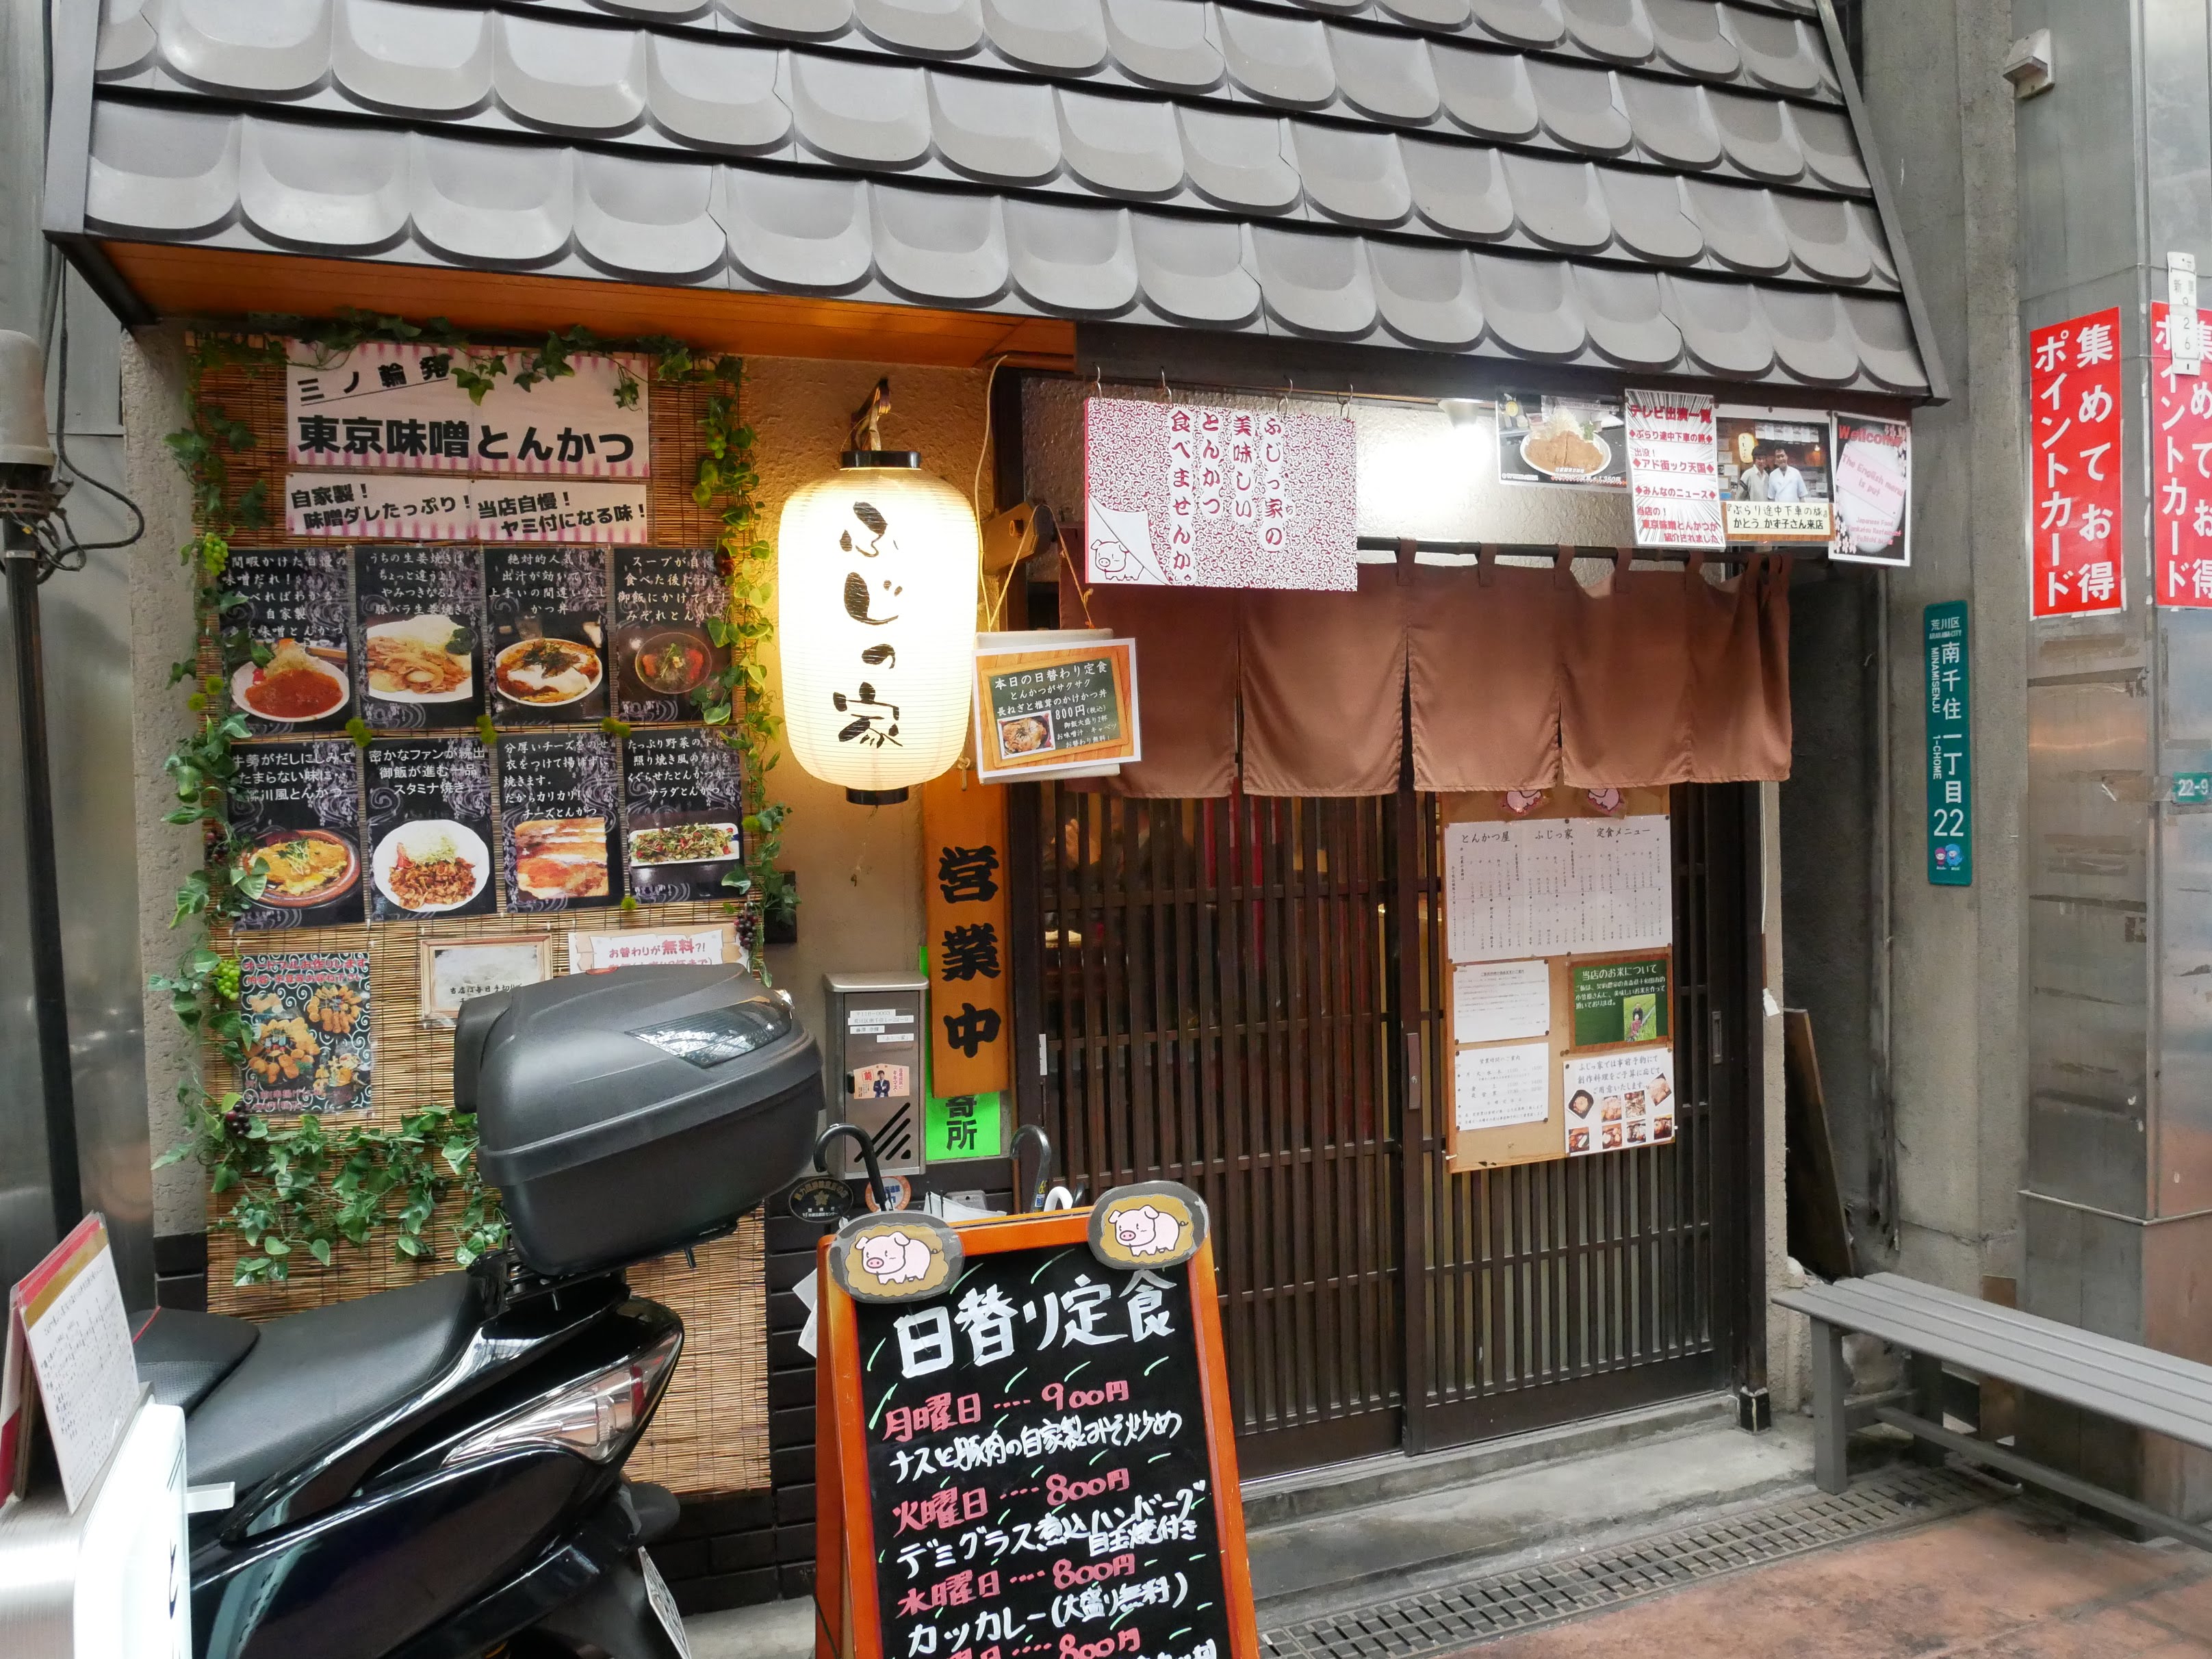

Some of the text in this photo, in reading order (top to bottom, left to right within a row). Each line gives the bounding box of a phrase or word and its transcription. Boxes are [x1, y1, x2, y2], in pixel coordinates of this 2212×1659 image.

[296, 355, 450, 402] 三ノ輪発
[297, 413, 634, 463] 東京味噌とんかつ
[1202, 413, 1222, 515] とんかつ
[1233, 415, 1252, 518] 美味しい
[2035, 330, 2072, 608] ポイントカード
[2076, 323, 2115, 604] 集めてお得
[1170, 409, 1192, 582] 食べませんか。
[1264, 417, 1284, 546] ふじっ家の
[291, 483, 369, 510] 自家製！
[477, 490, 571, 519] 当店自慢！
[225, 556, 346, 571] 間暇かけた自慢の
[370, 552, 463, 565] うちの生姜焼きは
[266, 607, 307, 621] 自家製
[375, 603, 463, 615] 豚バラ生姜焼き
[530, 602, 569, 615] かつ丼
[229, 624, 344, 639] 味噌とんかつ
[1930, 617, 1961, 632] 荒川区
[994, 660, 1109, 691] 本日の日替わり定食
[1009, 678, 1092, 701] とんかつがサクサク
[1931, 647, 1941, 713] MINAMISENJU
[1941, 641, 1963, 803] 南千住一丁目
[368, 747, 485, 764] 密かなファンが続出
[1932, 734, 1942, 780] 1-CHOME
[379, 764, 477, 780] 御飯が進む一品
[647, 786, 720, 798] サラダとんかつ
[2178, 778, 2209, 797] 22-9
[523, 807, 597, 820] チーズとんかつ
[1933, 808, 1964, 836] 22
[1461, 830, 1510, 843] とんかつ屋
[1597, 826, 1651, 838] 定食メニュー
[938, 845, 1002, 1059] 営業中
[1582, 964, 1658, 981] 当店のお米について
[893, 1269, 1178, 1378] 日替り定食
[882, 1380, 1129, 1442] 月曜日 900円
[892, 1467, 1130, 1538] 火曜日 800円
[895, 1552, 1136, 1619] 水曜日 800円
